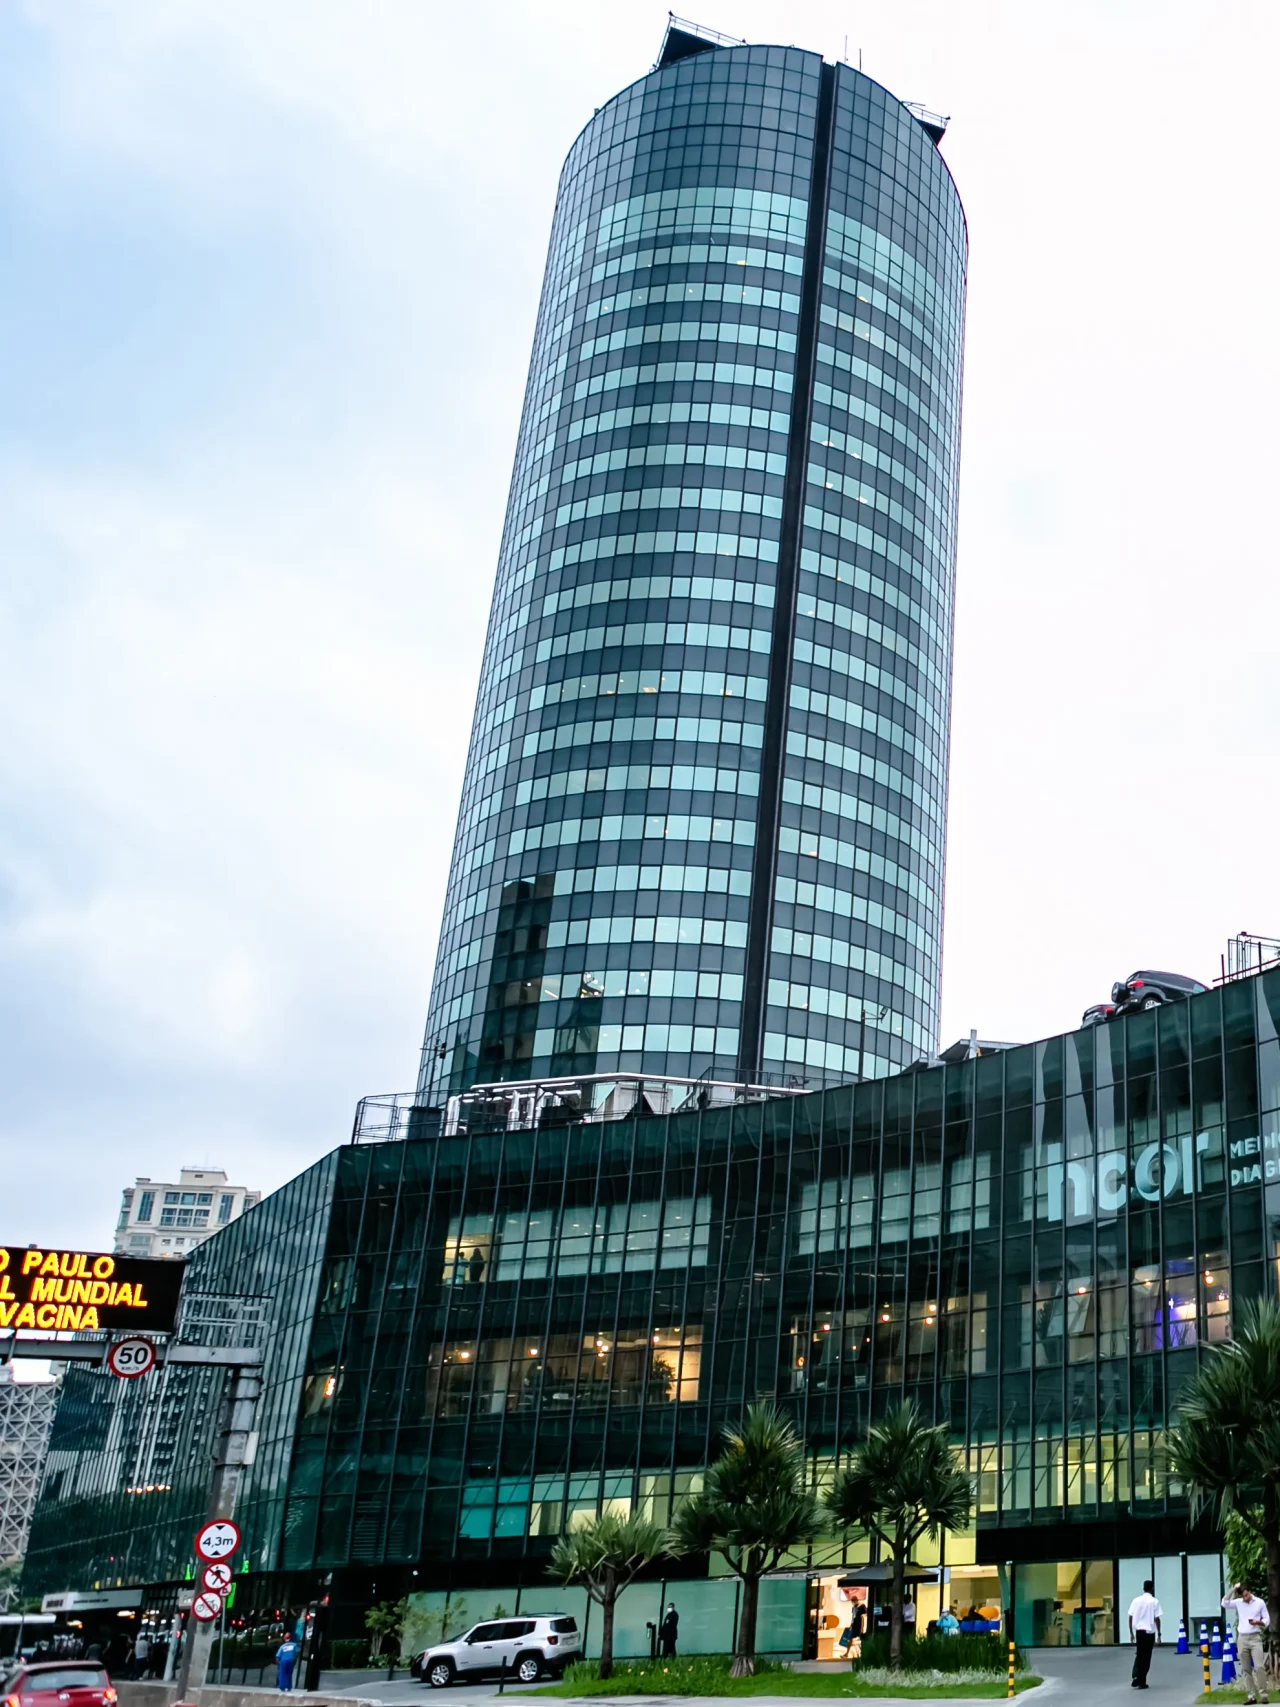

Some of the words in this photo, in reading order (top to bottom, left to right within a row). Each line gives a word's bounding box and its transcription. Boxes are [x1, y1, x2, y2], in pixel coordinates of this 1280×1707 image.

[1047, 1132, 1209, 1222] hcor
[22, 1250, 115, 1279] PAULO
[31, 1277, 148, 1307] MUNDIAL
[0, 1301, 99, 1330] VACINA
[118, 1347, 149, 1365] 50
[202, 1536, 234, 1549] 4,3m
